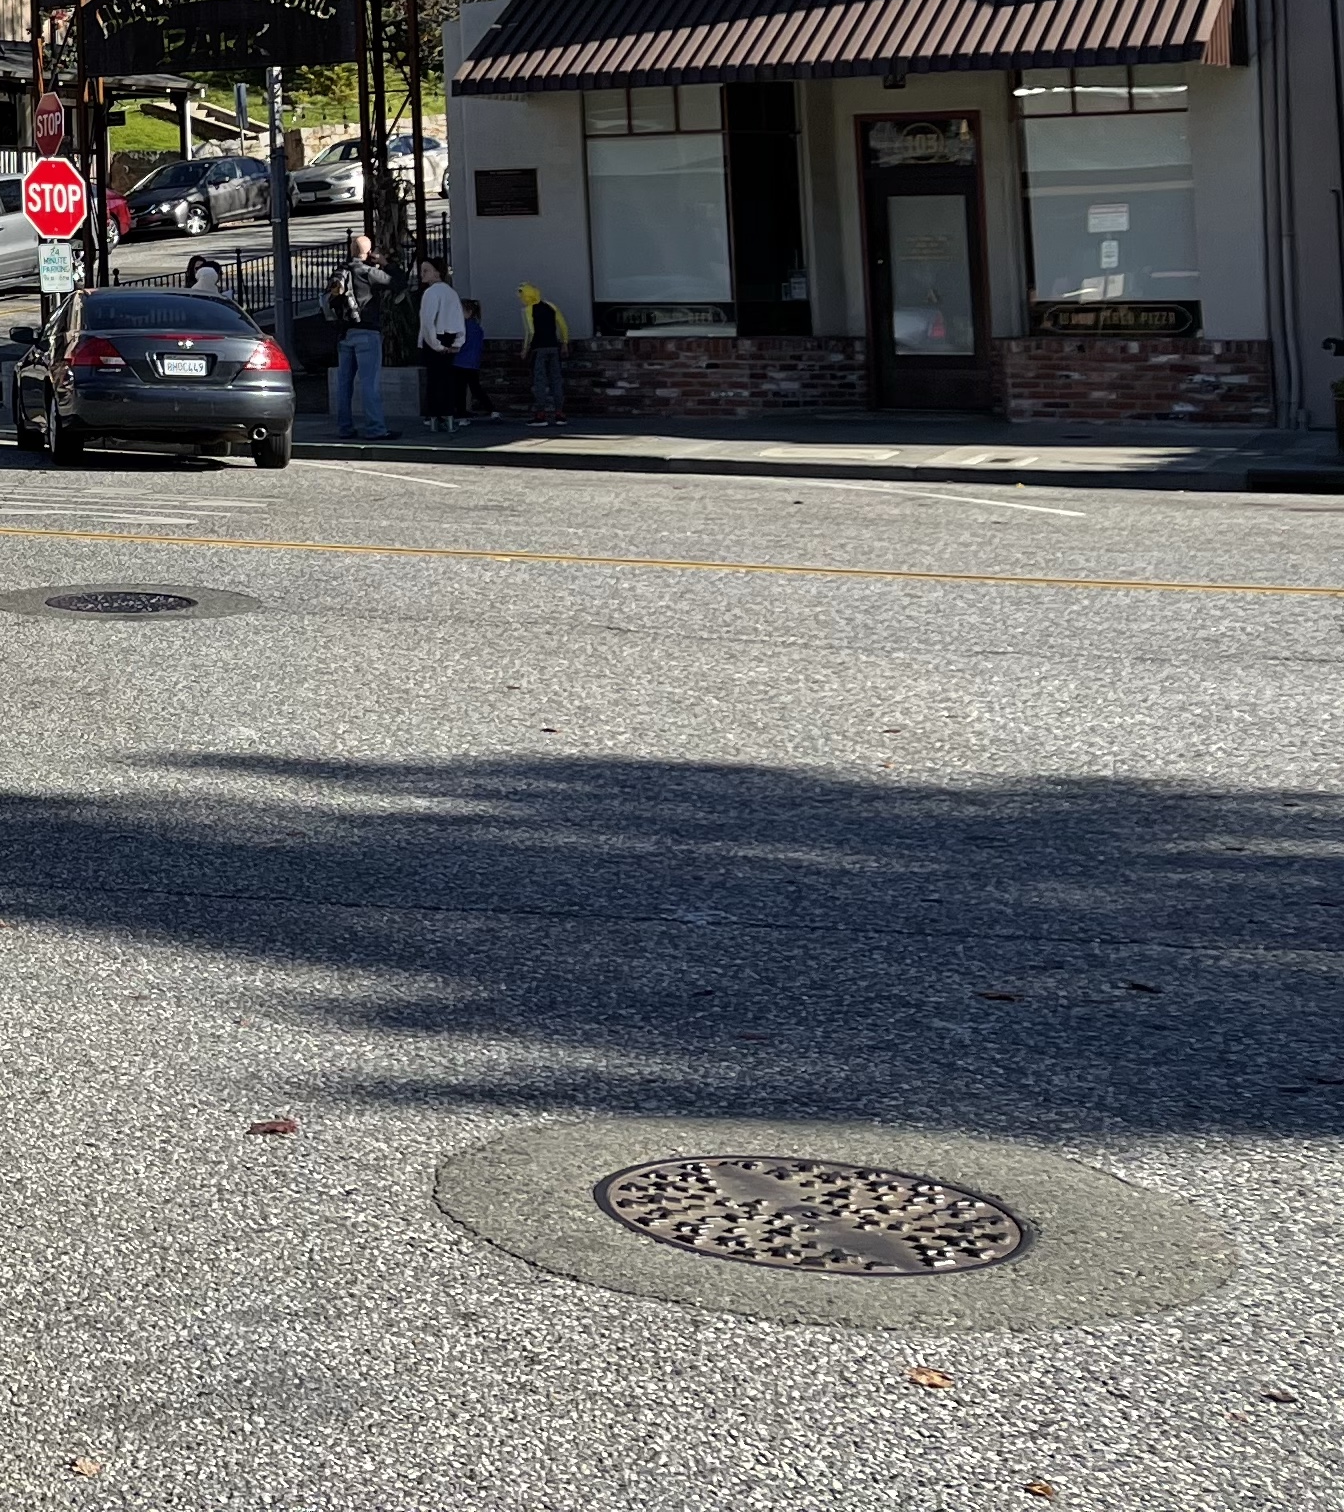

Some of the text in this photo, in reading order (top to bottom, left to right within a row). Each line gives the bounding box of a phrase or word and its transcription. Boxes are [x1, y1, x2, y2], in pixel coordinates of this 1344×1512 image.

[156, 23, 270, 64] PARK
[37, 112, 61, 137] STOP
[28, 183, 81, 213] STOP
[43, 265, 70, 273] PARKING
[1141, 312, 1176, 324] PIZZA
